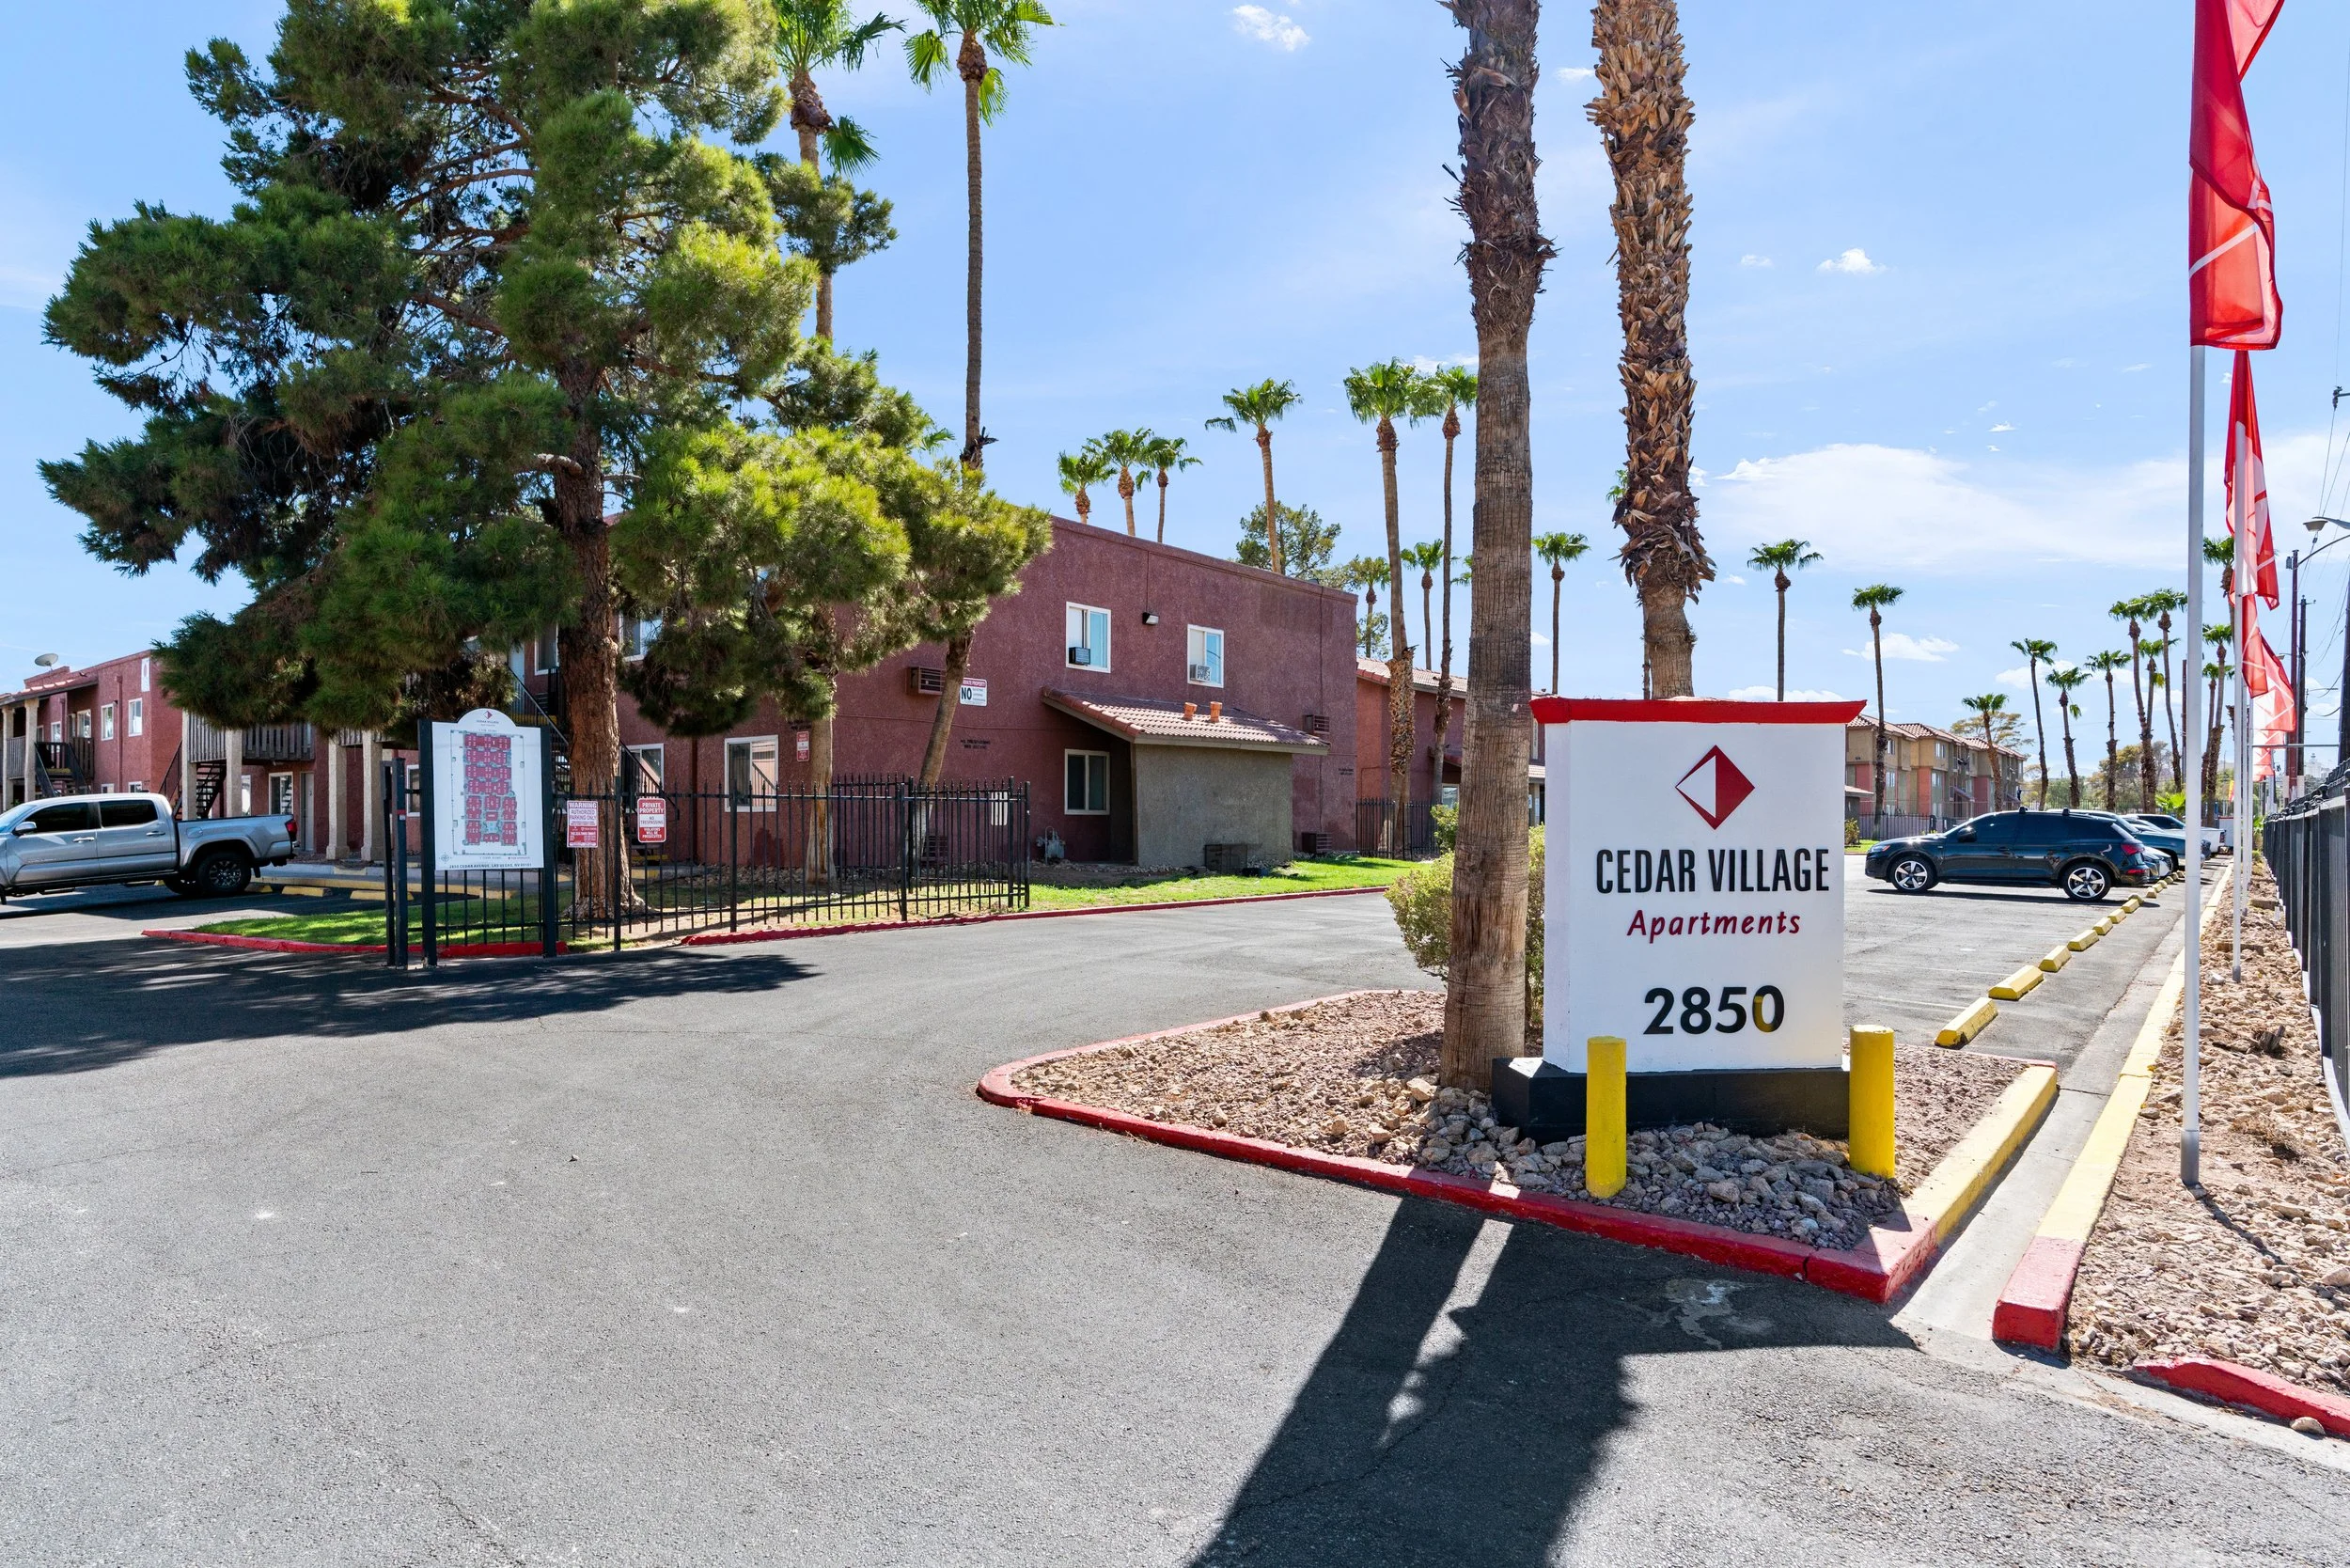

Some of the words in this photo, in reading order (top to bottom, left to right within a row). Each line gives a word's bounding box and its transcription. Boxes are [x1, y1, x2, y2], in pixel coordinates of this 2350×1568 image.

[961, 687, 972, 700] NO
[1596, 849, 1696, 894] CEDAR
[1708, 848, 1829, 892] VILLAGE
[1627, 910, 1801, 944] Apartments
[1643, 984, 1785, 1035] 2850
